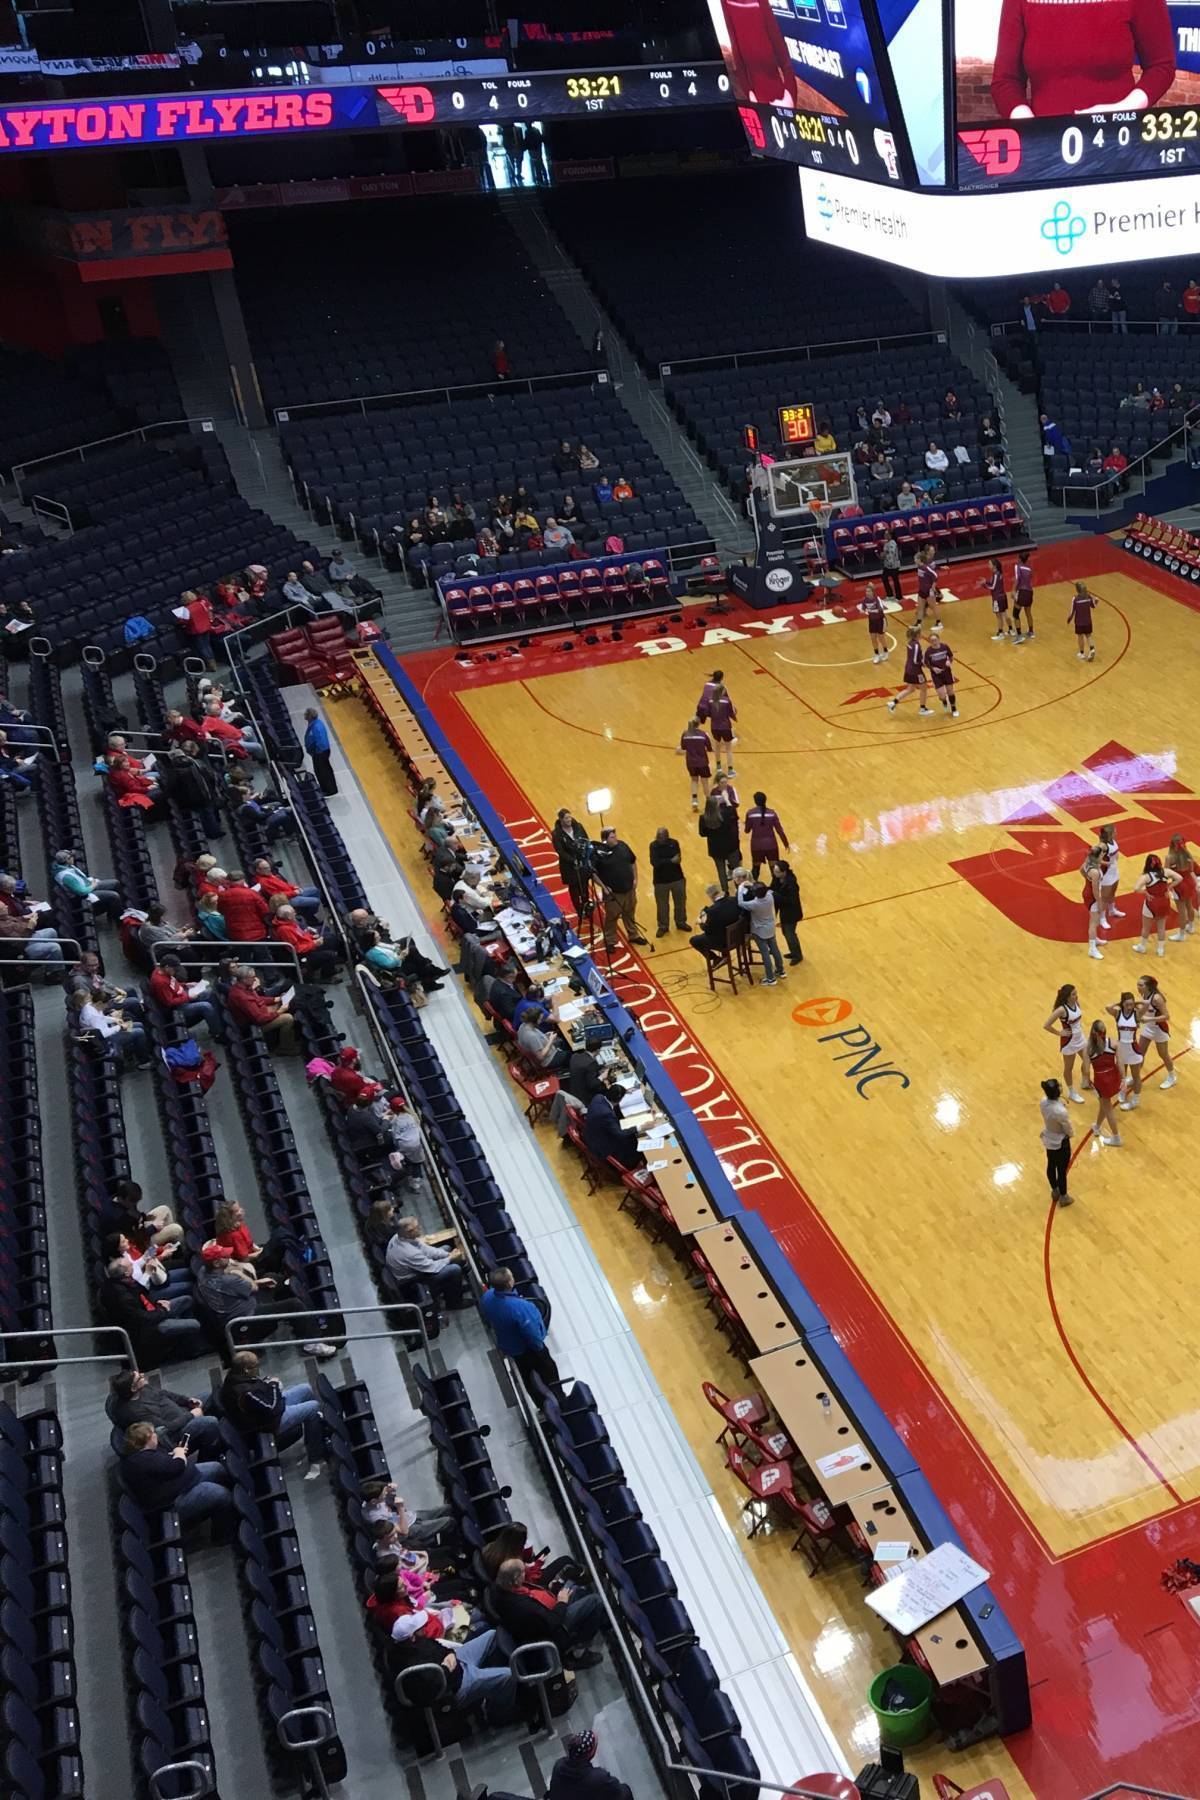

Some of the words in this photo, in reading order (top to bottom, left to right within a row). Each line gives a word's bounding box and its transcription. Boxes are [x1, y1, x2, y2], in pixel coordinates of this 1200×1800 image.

[650, 71, 673, 79] FOULS
[682, 70, 697, 78] TOL
[482, 82, 498, 90] TOL
[507, 80, 531, 88] FOULS
[566, 76, 622, 97] 33:21
[659, 83, 671, 98] 0
[687, 82, 698, 96] 4
[718, 74, 730, 92] 0
[453, 91, 466, 110] 0
[488, 95, 499, 110] 4
[517, 93, 529, 108] 0
[585, 99, 605, 110] 1ST
[156, 93, 333, 137] FLYERS
[1091, 114, 1107, 124] TOL
[1112, 112, 1137, 122] FOULS
[795, 113, 826, 143] 33:21
[1092, 129, 1105, 148] 4
[1118, 127, 1130, 147] 0
[1061, 126, 1084, 165] 0
[1159, 149, 1186, 165] 1ST
[1093, 204, 1187, 235] Premier
[782, 408, 811, 421] 33:21
[788, 419, 810, 439] 30
[817, 1022, 911, 1100] PNC
